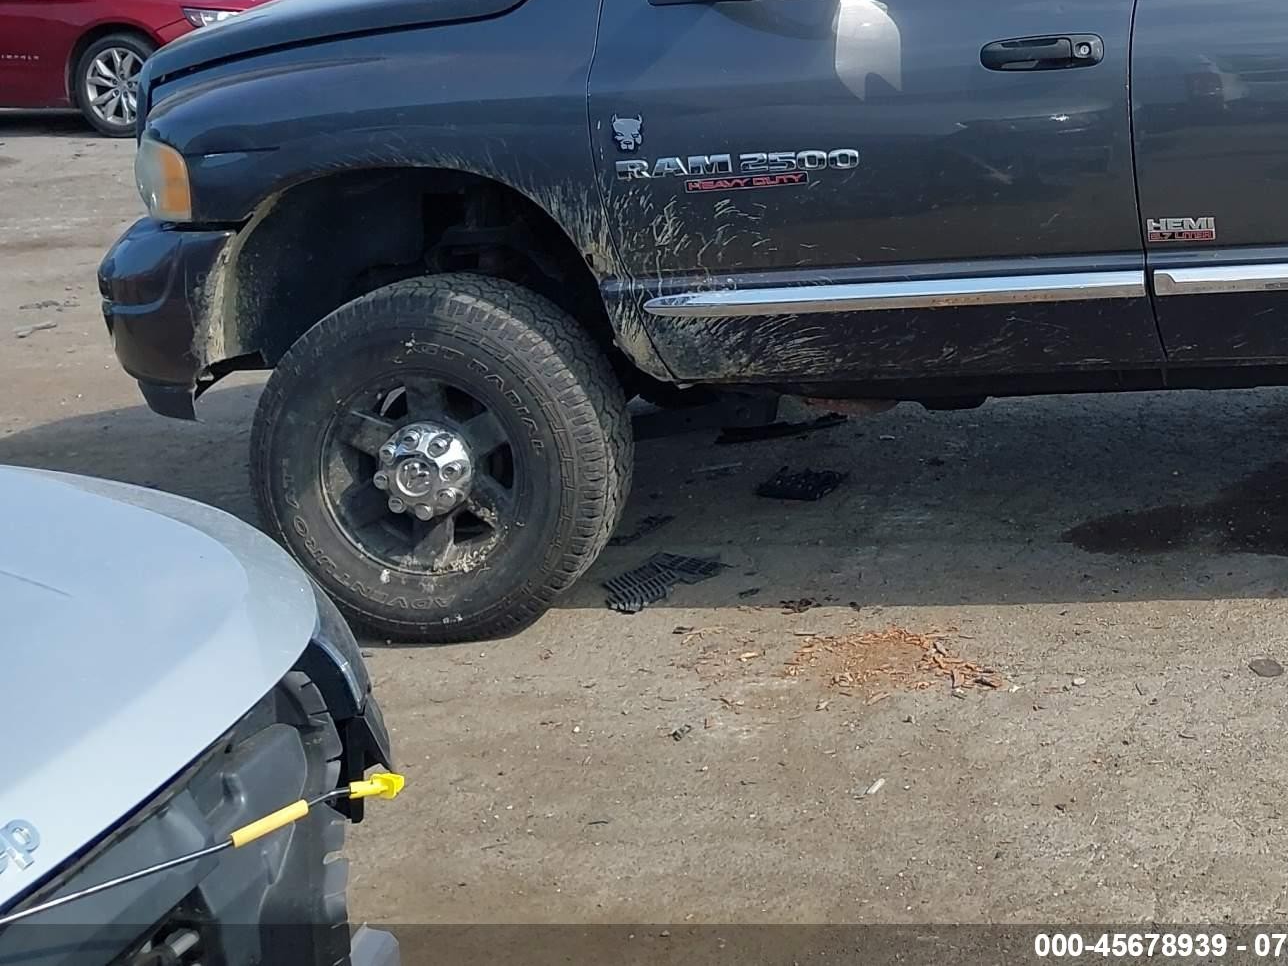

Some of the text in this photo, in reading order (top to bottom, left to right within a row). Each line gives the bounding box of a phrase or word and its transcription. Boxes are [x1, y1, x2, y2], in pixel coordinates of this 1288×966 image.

[615, 149, 860, 180] RAM 2500
[688, 173, 804, 191] HEAVY DUTY
[1146, 217, 1215, 232] HEMI
